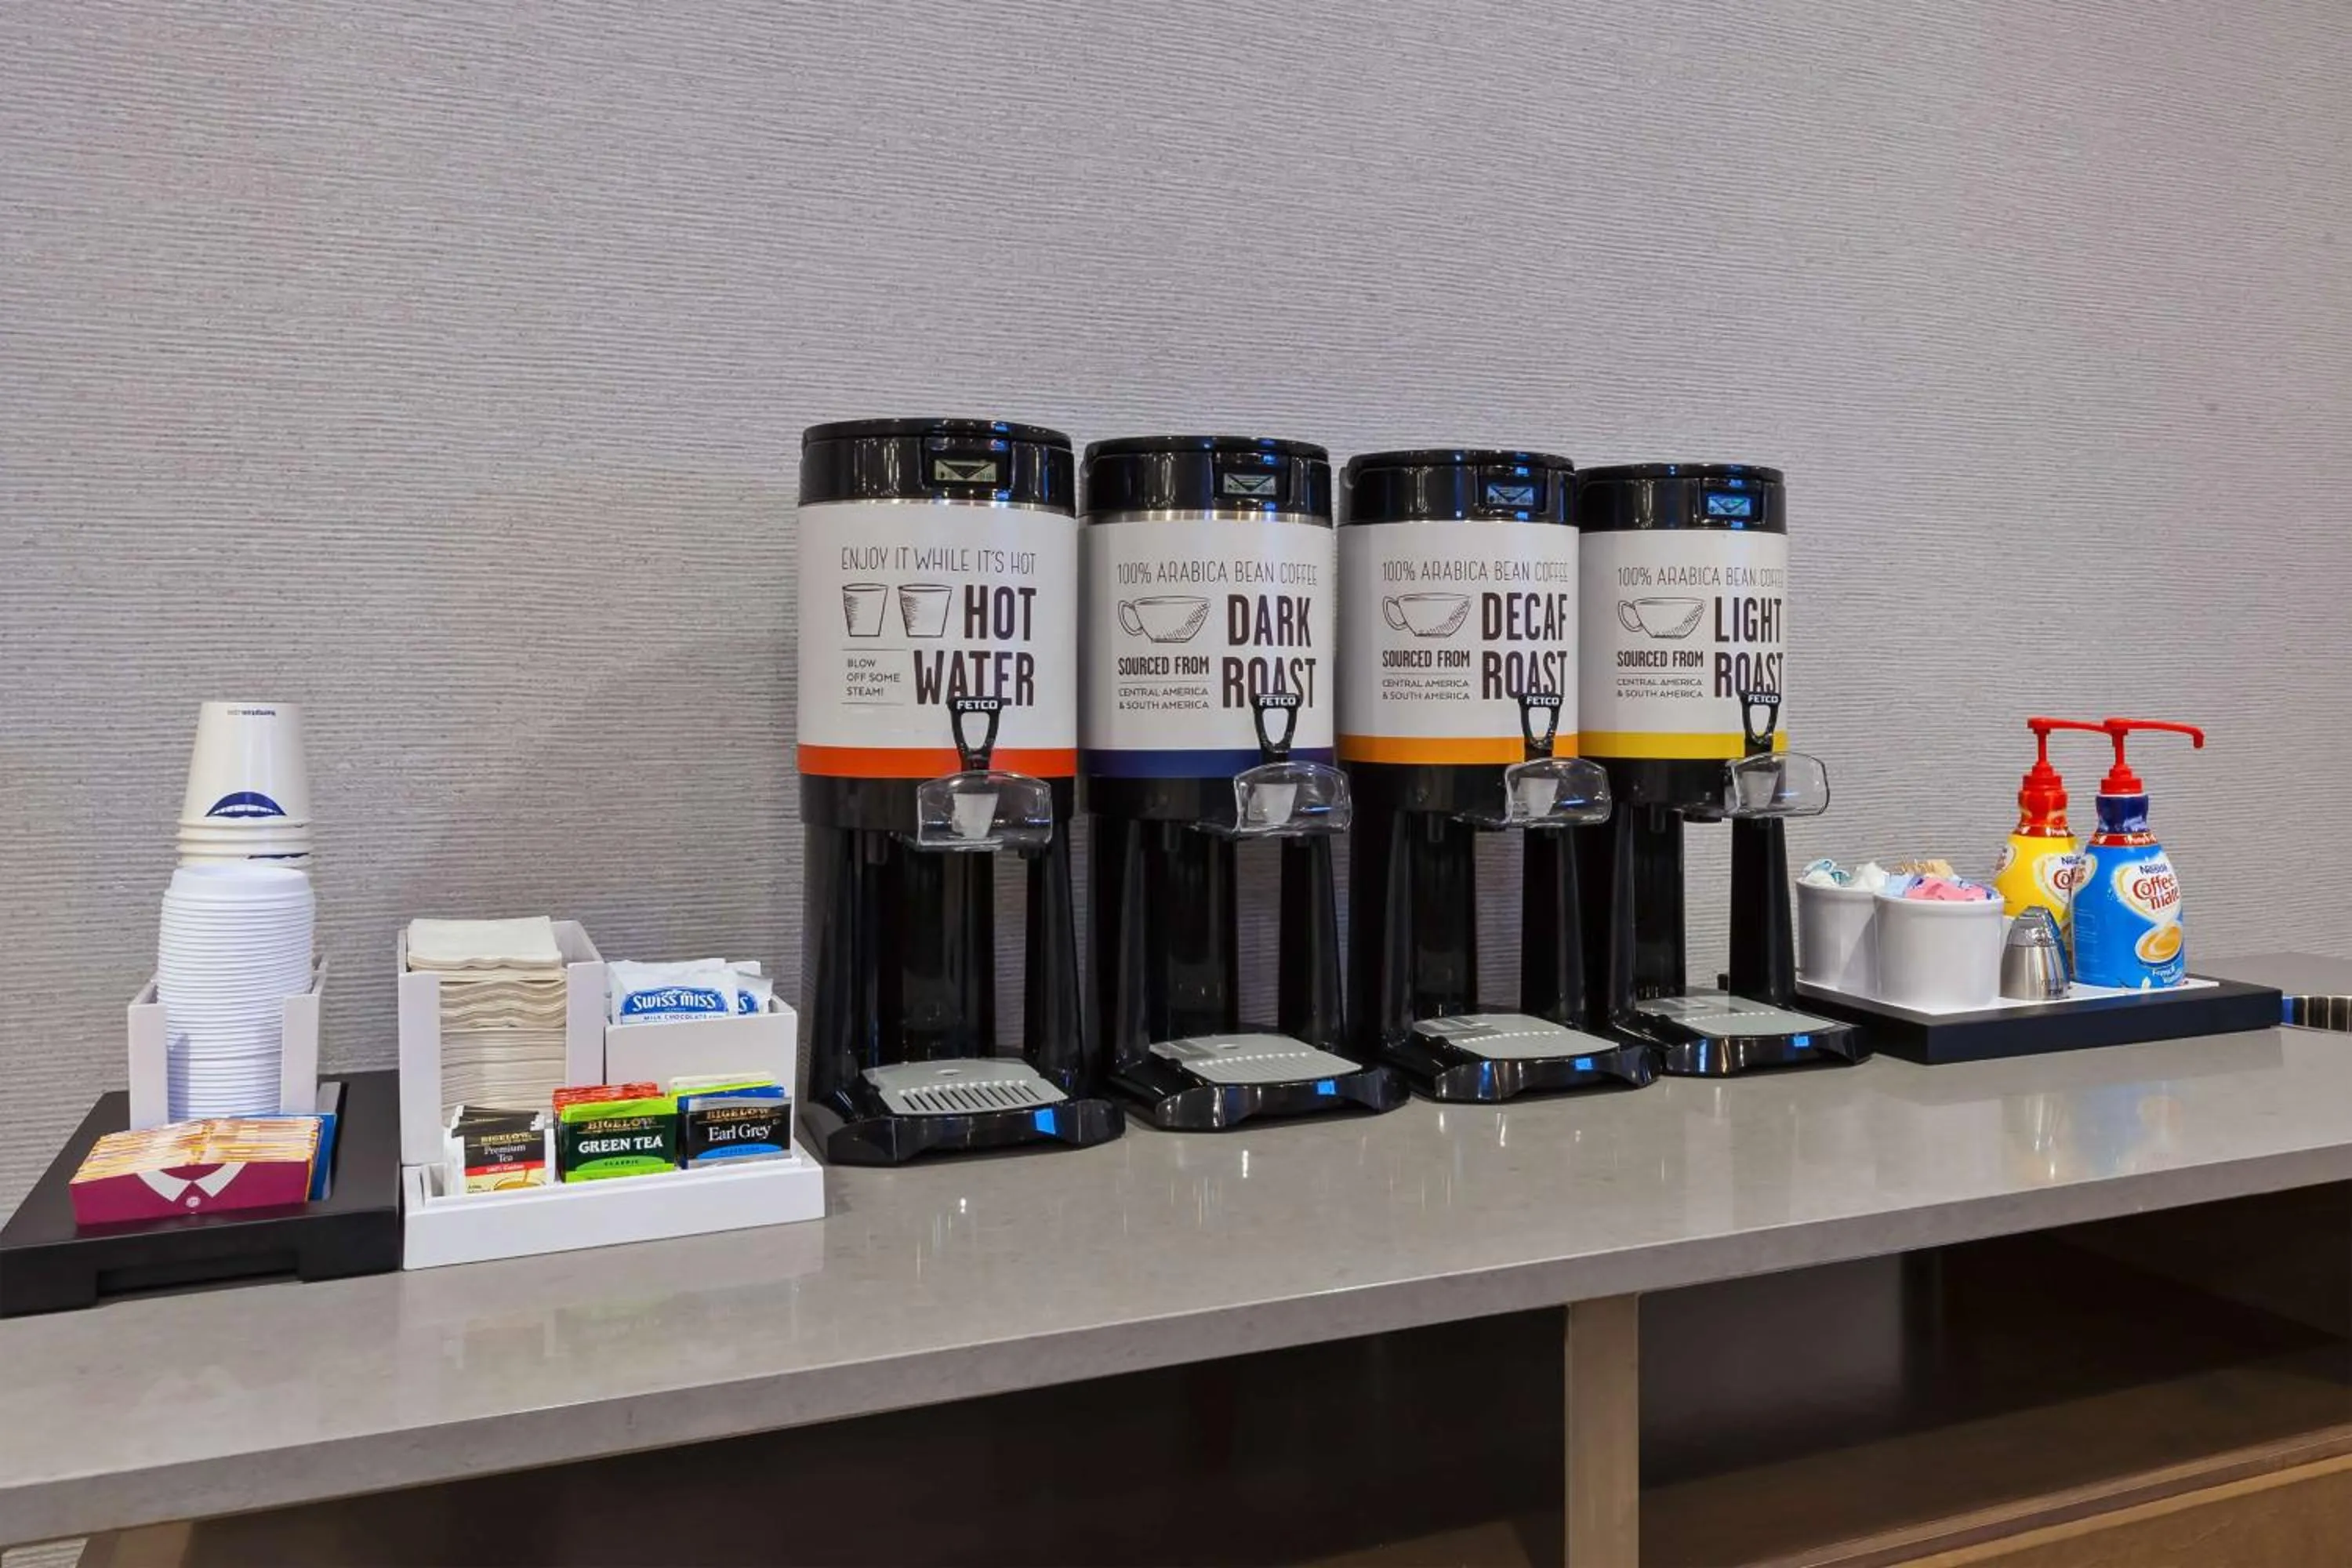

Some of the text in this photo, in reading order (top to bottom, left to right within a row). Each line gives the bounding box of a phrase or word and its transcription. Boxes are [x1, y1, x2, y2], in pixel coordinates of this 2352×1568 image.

[841, 546, 1036, 575] ENJOY IT WHILE IT'S HOT
[1116, 561, 1318, 586] 100% ARABICA BEAN COFFEE
[1382, 561, 1415, 582] 100%
[1421, 561, 1488, 582] ARABICA
[1495, 561, 1529, 582] BEAN
[1618, 567, 1652, 586] 100%
[1657, 566, 1721, 586] ARABICA
[1725, 567, 1757, 586] BEAN
[964, 584, 1036, 641] HOT
[1227, 593, 1312, 648] DARK
[1482, 592, 1567, 641] DECAF
[1715, 596, 1782, 643] LIGHT
[848, 658, 877, 668] BLOW
[1118, 655, 1210, 677] SOURCED FROM
[1382, 650, 1470, 668] SOURCED FROM
[1617, 650, 1704, 667] SOURCED FROM
[847, 672, 901, 682] OFF SOME
[913, 649, 1035, 706] WATER
[1222, 656, 1316, 709] ROAST
[1382, 679, 1469, 688] CENTRAL AMERICA
[1482, 650, 1567, 700] ROAST
[1715, 652, 1784, 698] ROAST
[846, 686, 884, 697] STEAM!
[1118, 688, 1209, 697] CENTRAL AMERICA
[1388, 691, 1422, 700] SOUTH
[1424, 691, 1470, 700] AMERICA
[1659, 689, 1704, 698] AMERICA
[1748, 694, 1780, 704] FETCO
[956, 700, 998, 710] FETCO
[1119, 700, 1210, 710] & SOUTH AMERICA
[1258, 696, 1297, 706] FETCO
[1526, 697, 1559, 706] FETCO
[706, 1107, 770, 1120] BIGELOW
[586, 1116, 655, 1131] BIGELOW
[708, 1123, 772, 1142] Earl Grey
[484, 1144, 526, 1155] Premium
[578, 1134, 663, 1153] GREEN TEA
[499, 1153, 514, 1163] Tea
